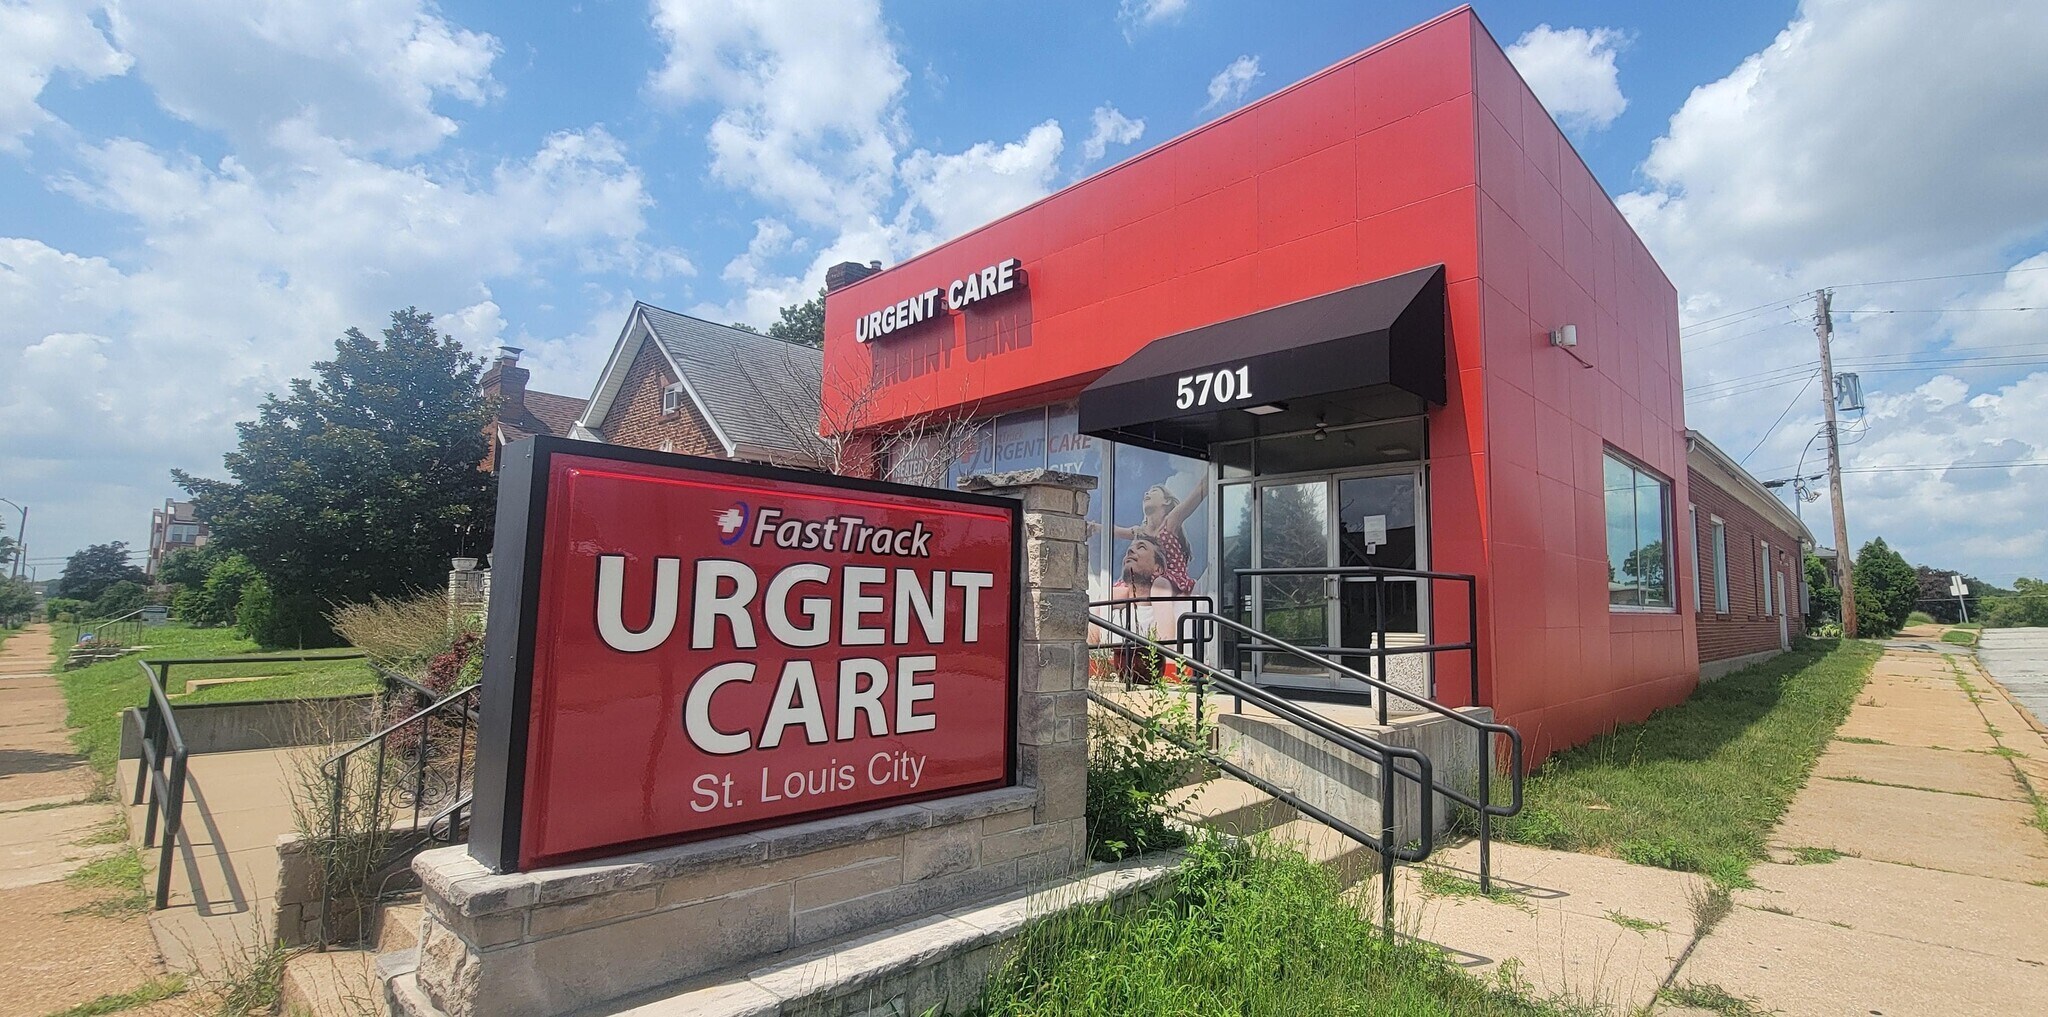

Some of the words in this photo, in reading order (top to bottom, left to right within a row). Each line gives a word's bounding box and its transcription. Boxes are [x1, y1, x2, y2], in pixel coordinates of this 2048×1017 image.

[856, 288, 939, 343] URGENT
[949, 258, 1014, 310] CARE
[1176, 365, 1253, 410] 5701
[983, 438, 1046, 464] URGENT
[1048, 434, 1092, 454] CARE
[752, 508, 932, 557] FastTrack
[597, 556, 994, 652] URGENT
[684, 655, 937, 755] CARE
[690, 772, 743, 813] St.
[761, 758, 856, 803] Louis
[868, 750, 927, 788] City
